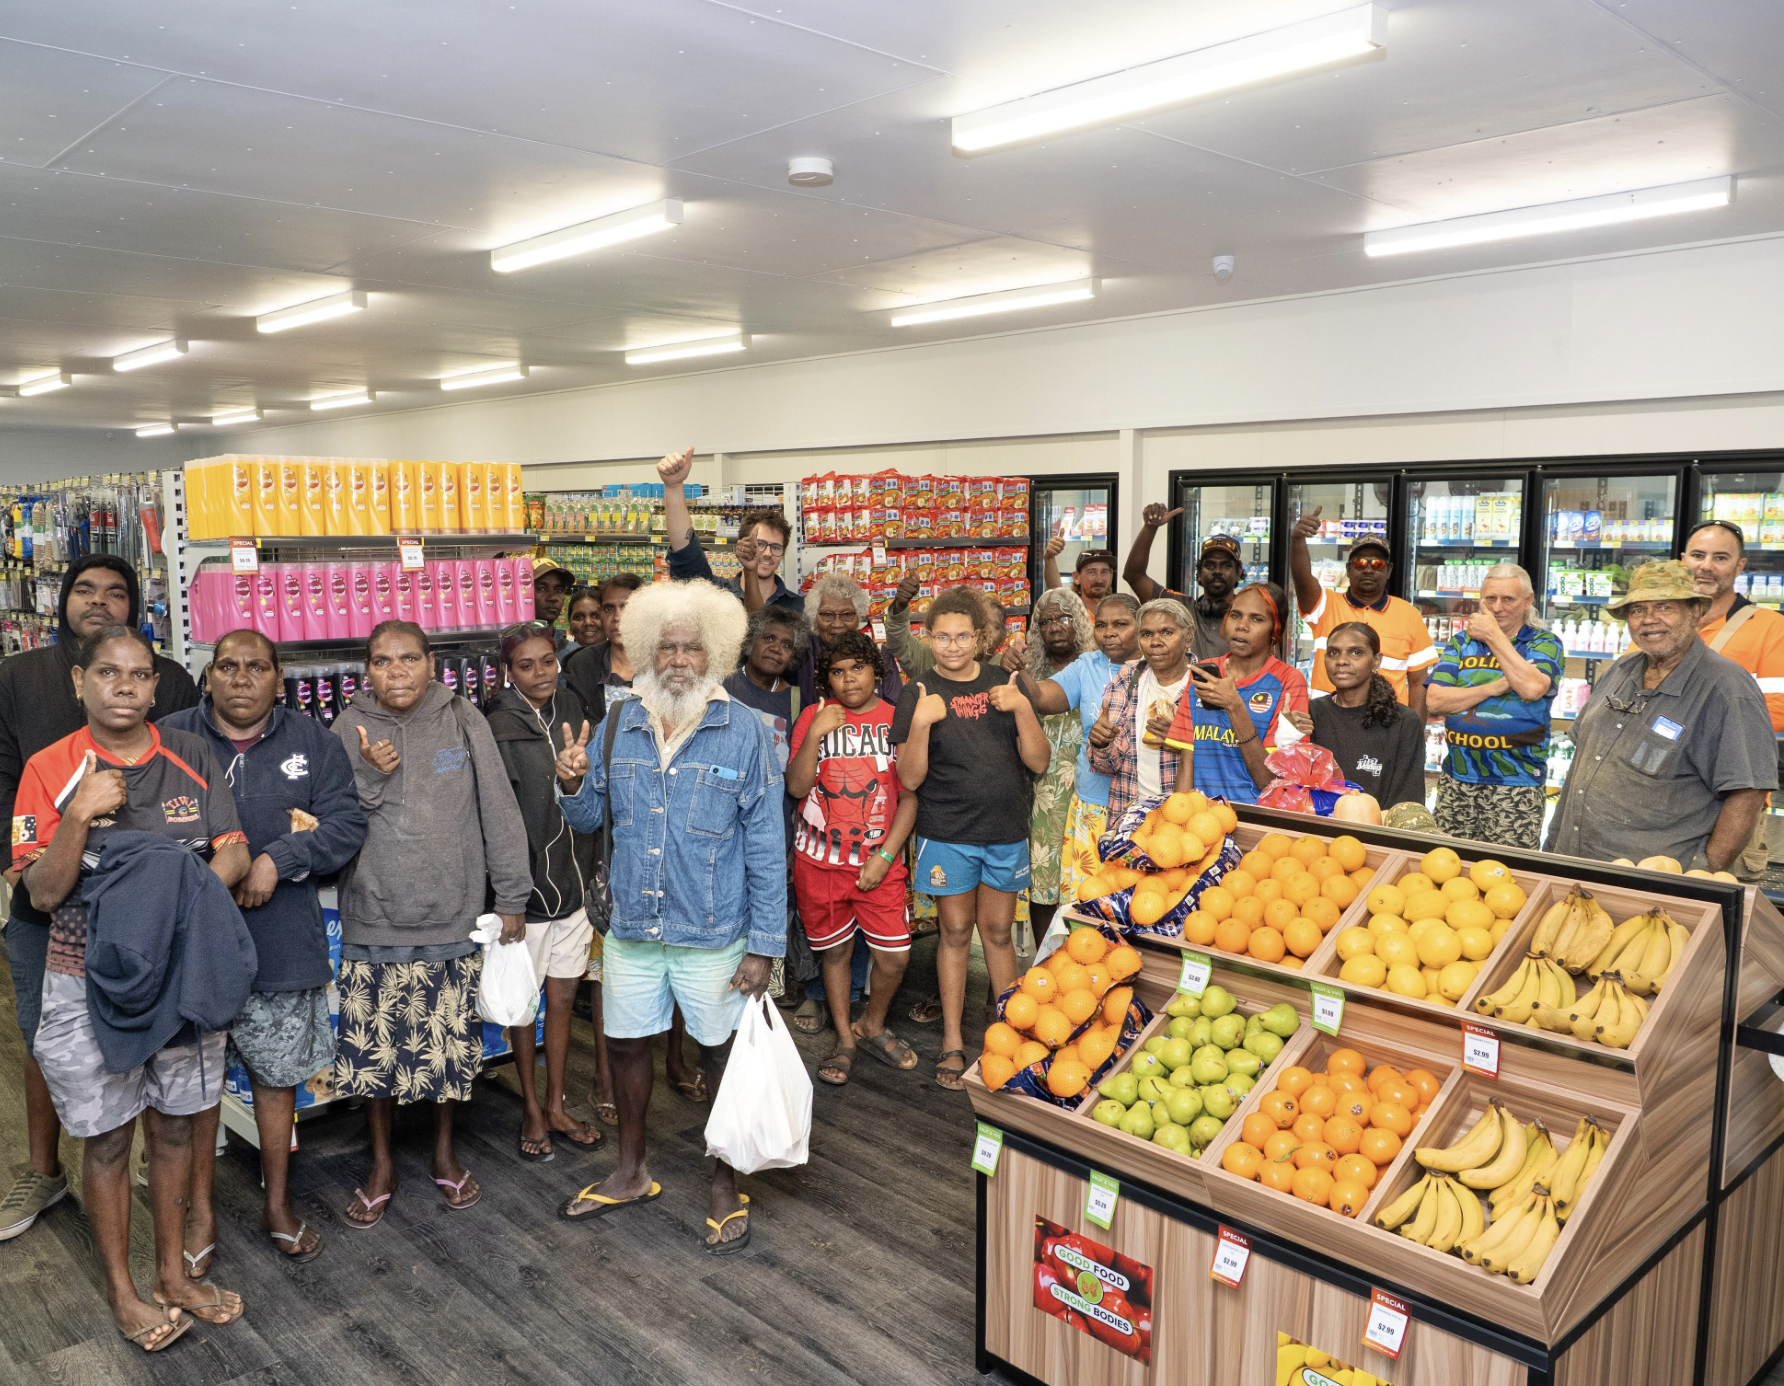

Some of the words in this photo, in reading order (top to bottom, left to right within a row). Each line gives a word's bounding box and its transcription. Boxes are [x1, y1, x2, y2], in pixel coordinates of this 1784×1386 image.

[166, 796, 194, 810] TIWI
[1466, 1025, 1496, 1036] SPECIAL
[1474, 1049, 1489, 1059] $2.99
[1223, 1230, 1248, 1245] SPECIAL
[1058, 1248, 1090, 1270] GOOD
[1093, 1264, 1124, 1287] FOOD
[1223, 1257, 1238, 1268] $2.99
[1053, 1286, 1092, 1312] STRONG
[1093, 1306, 1130, 1332] BODIES
[1376, 1294, 1406, 1311] SPECIAL
[1378, 1322, 1394, 1335] $2.99
